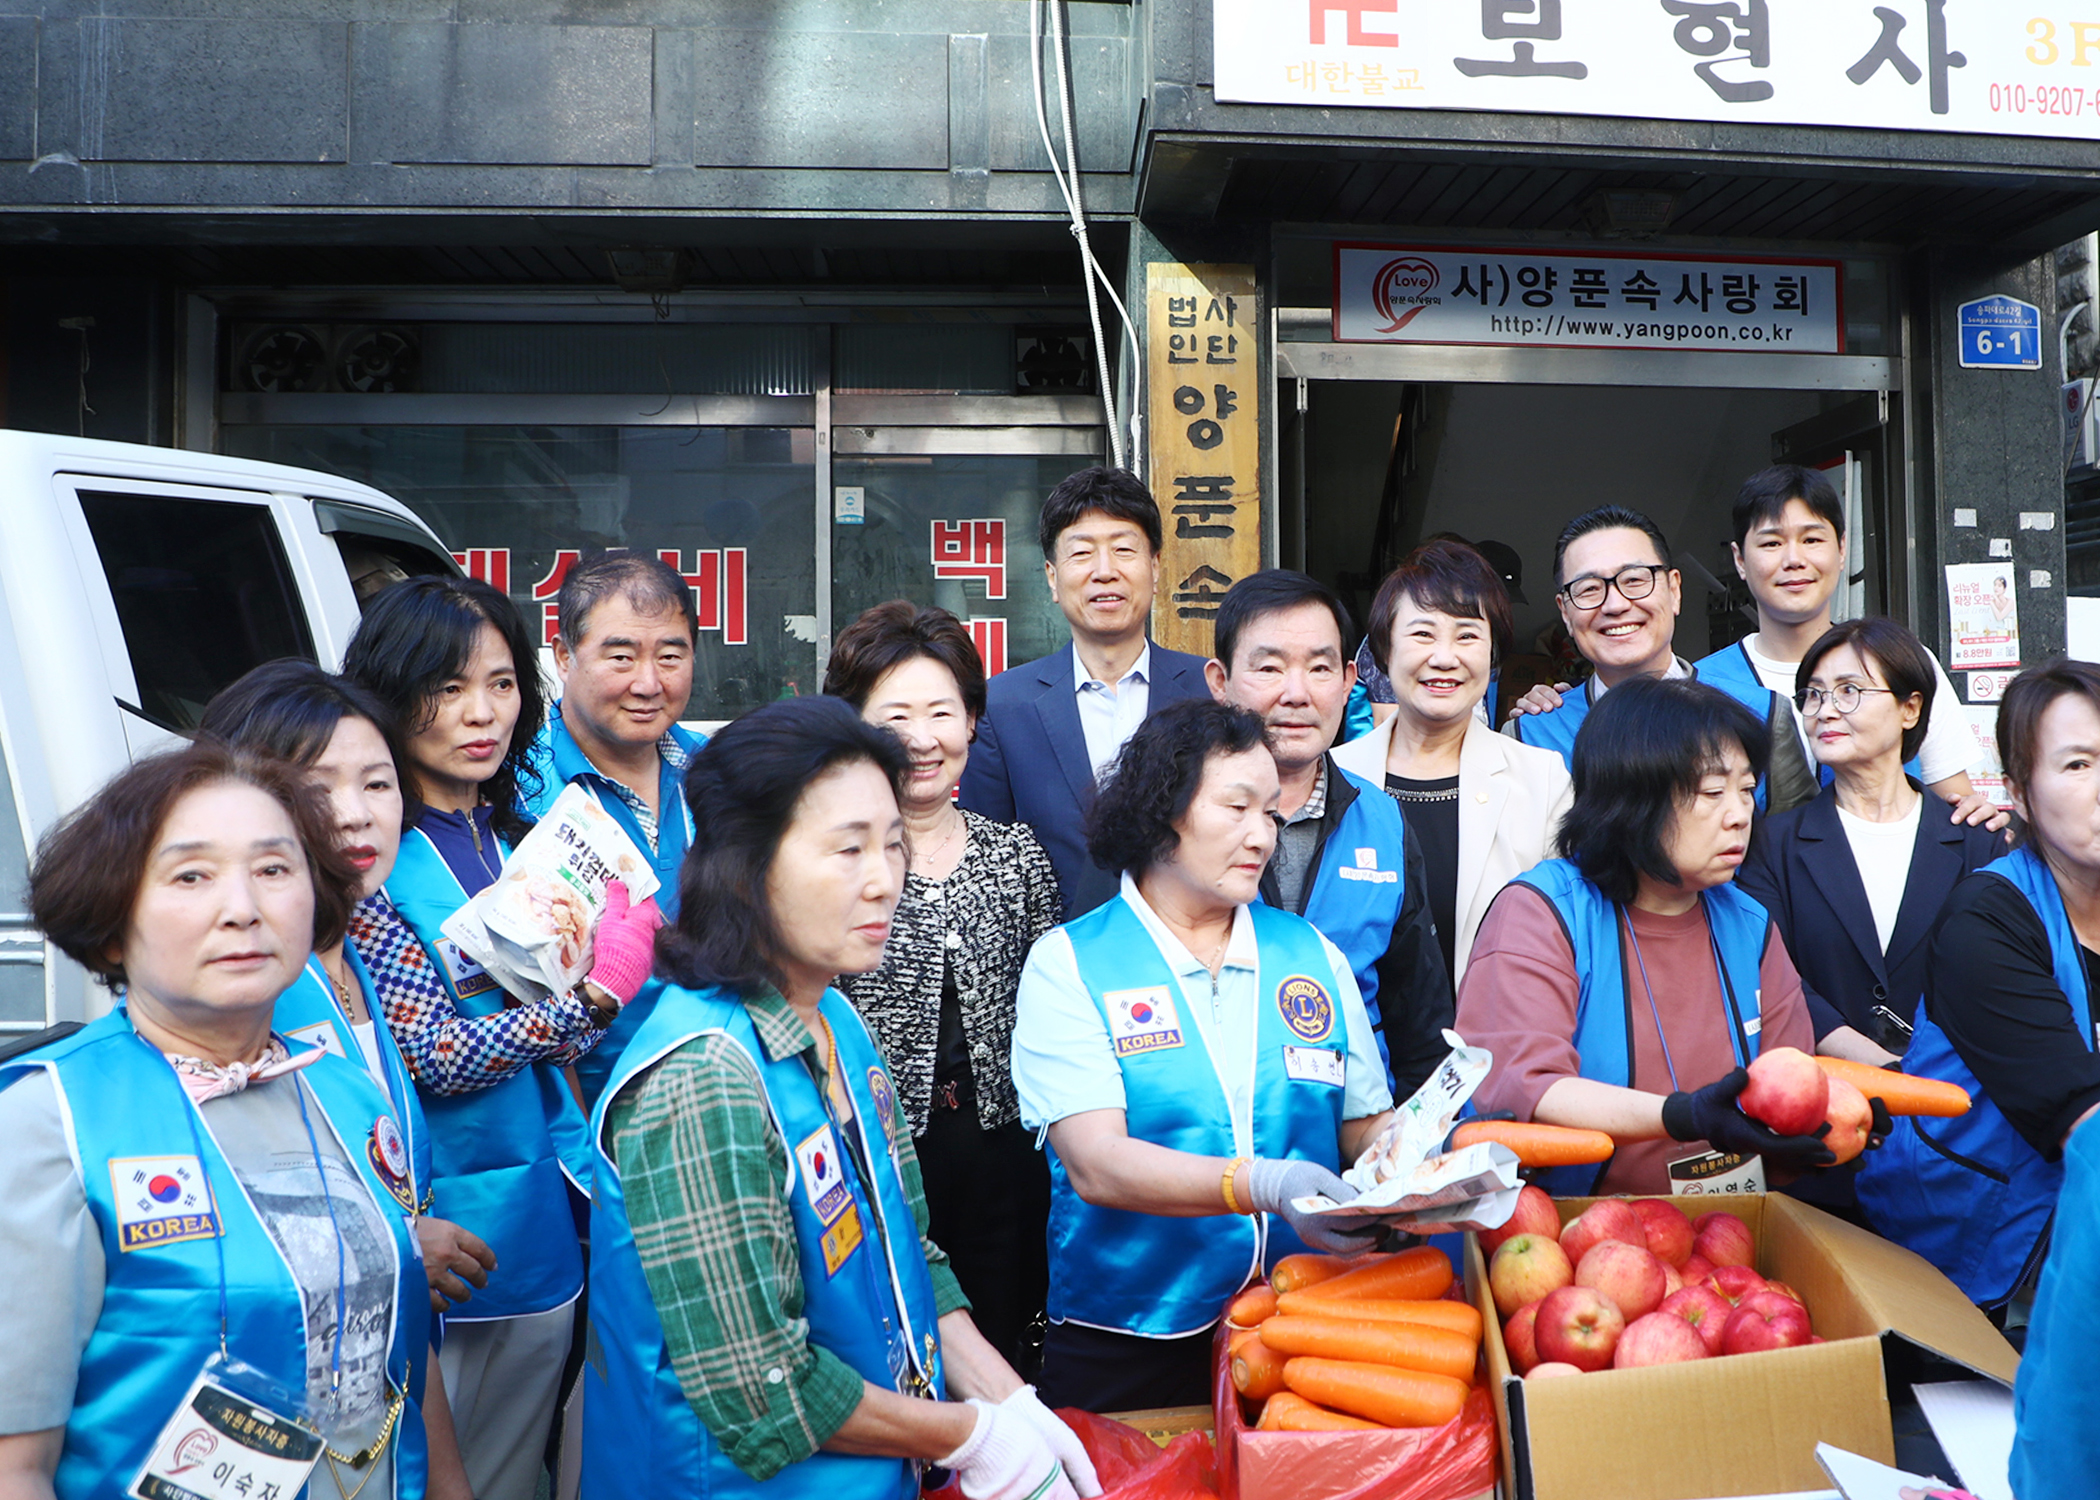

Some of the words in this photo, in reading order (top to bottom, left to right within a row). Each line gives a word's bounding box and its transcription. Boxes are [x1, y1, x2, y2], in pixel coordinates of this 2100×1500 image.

[1285, 60, 1426, 95] 대한불교
[1394, 273, 1428, 287] Love
[1491, 314, 1793, 342] http://www.yangpoon.co.kr
[1977, 330, 2021, 355] 6-1
[458, 971, 494, 995] KORE
[1288, 983, 1317, 996] LIONS
[1121, 1031, 1177, 1052] KOREA
[817, 1185, 846, 1216] KOREA
[129, 1214, 215, 1243] KOREA
